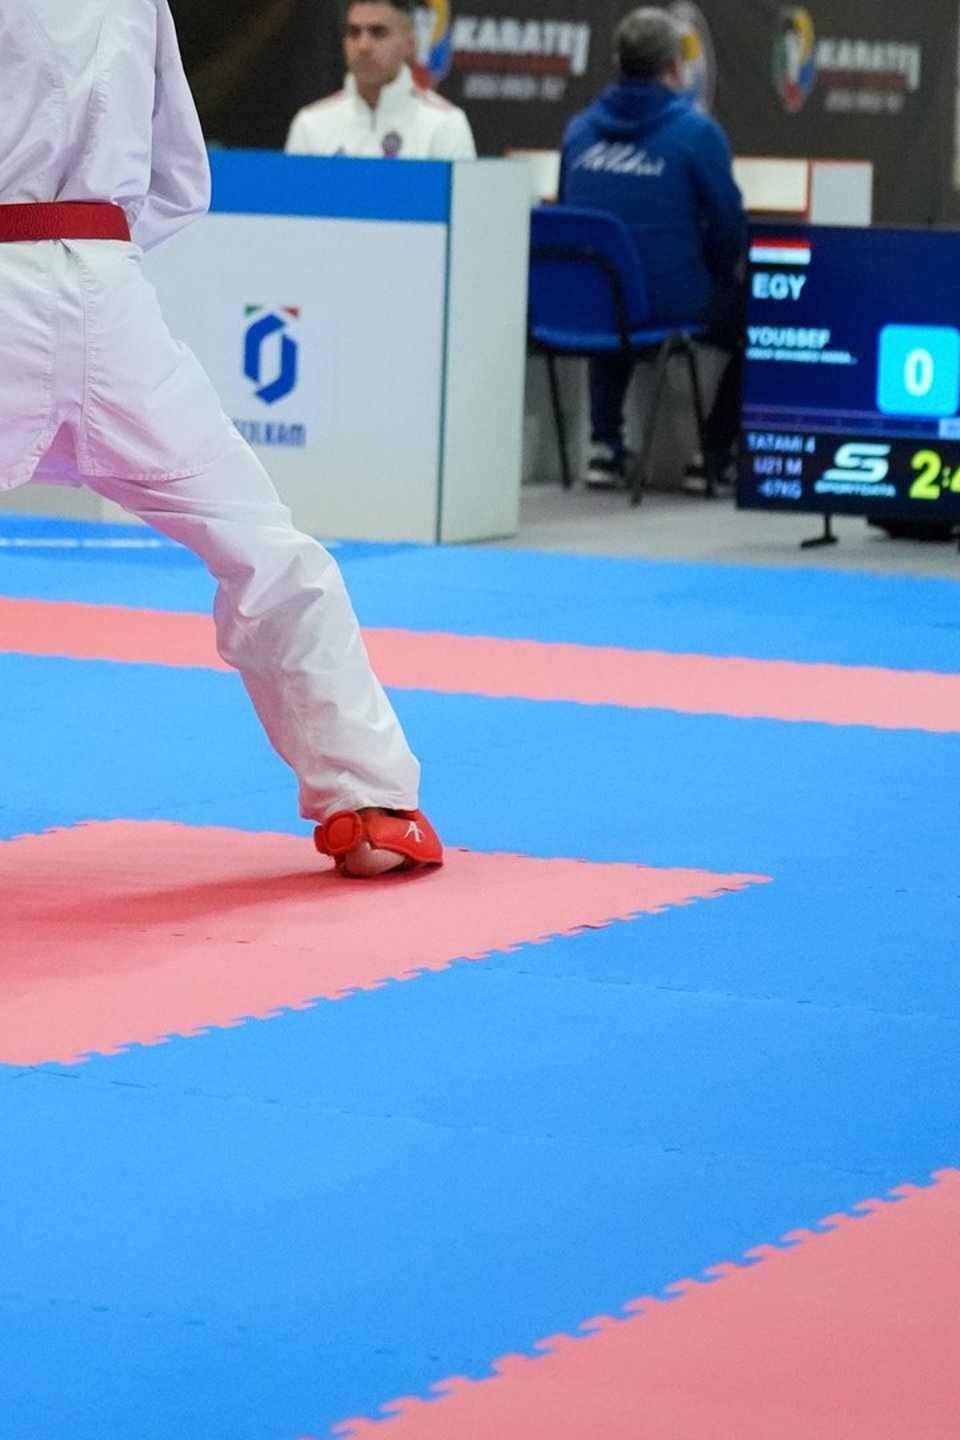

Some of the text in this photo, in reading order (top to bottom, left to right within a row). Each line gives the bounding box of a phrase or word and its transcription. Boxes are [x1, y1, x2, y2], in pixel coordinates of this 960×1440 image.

[752, 272, 806, 301] EGY
[746, 326, 831, 349] YOUSSEF
[903, 347, 935, 397] 0
[746, 432, 804, 454] TATAMI
[753, 456, 803, 476] U21 M
